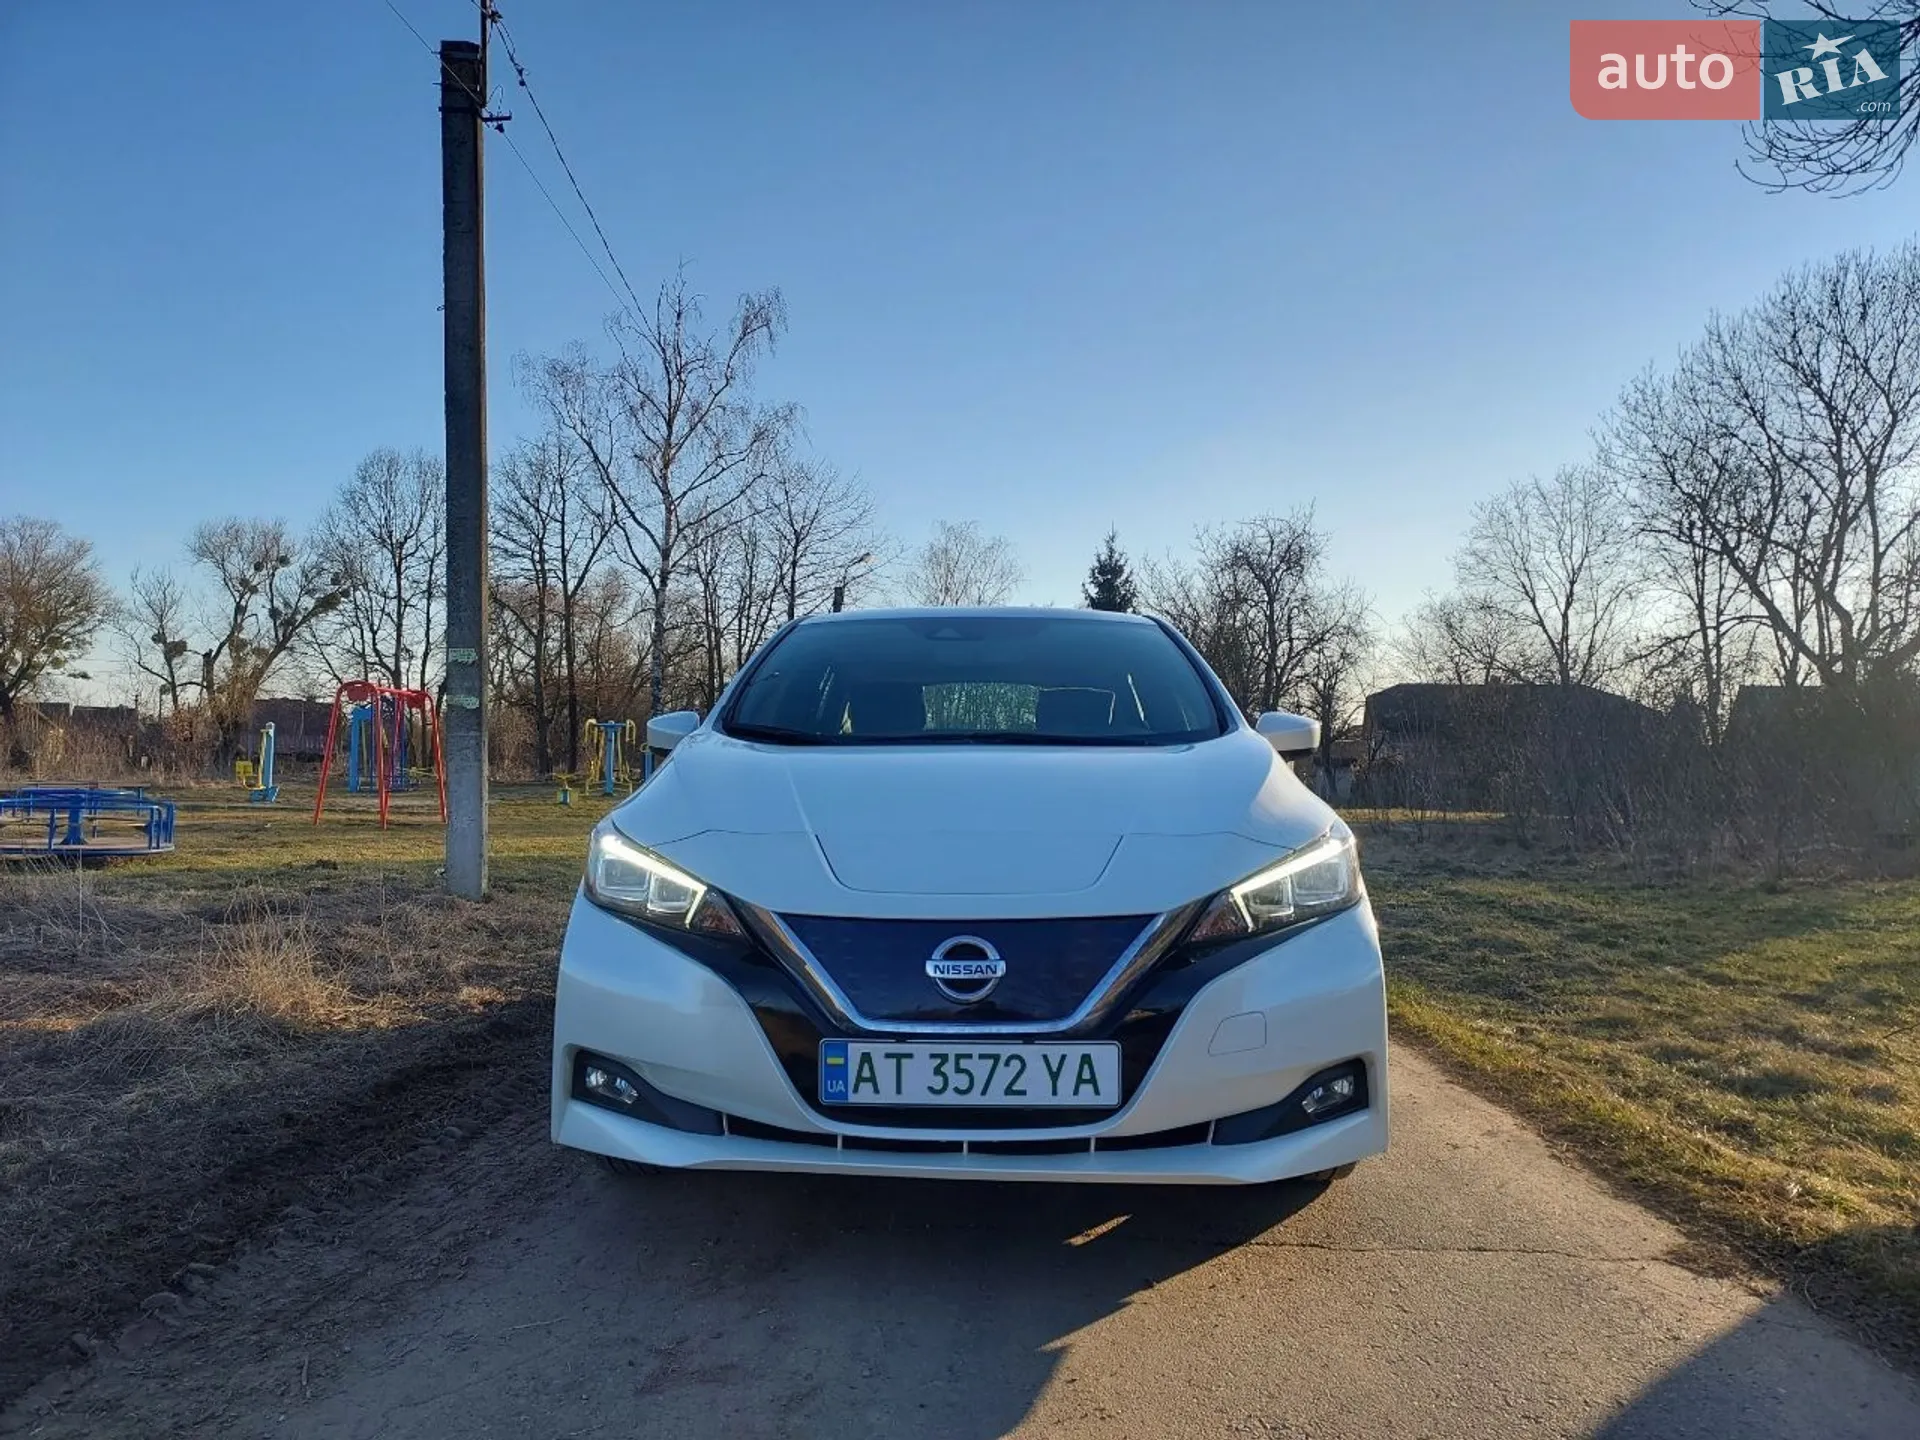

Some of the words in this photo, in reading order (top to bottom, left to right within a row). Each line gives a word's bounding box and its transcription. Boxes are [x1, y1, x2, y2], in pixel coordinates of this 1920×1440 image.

[934, 964, 997, 975] NISSAN
[852, 1051, 914, 1095] AT
[927, 1053, 1027, 1096] 3572
[1042, 1053, 1100, 1096] YA
[827, 1079, 846, 1093] UA
